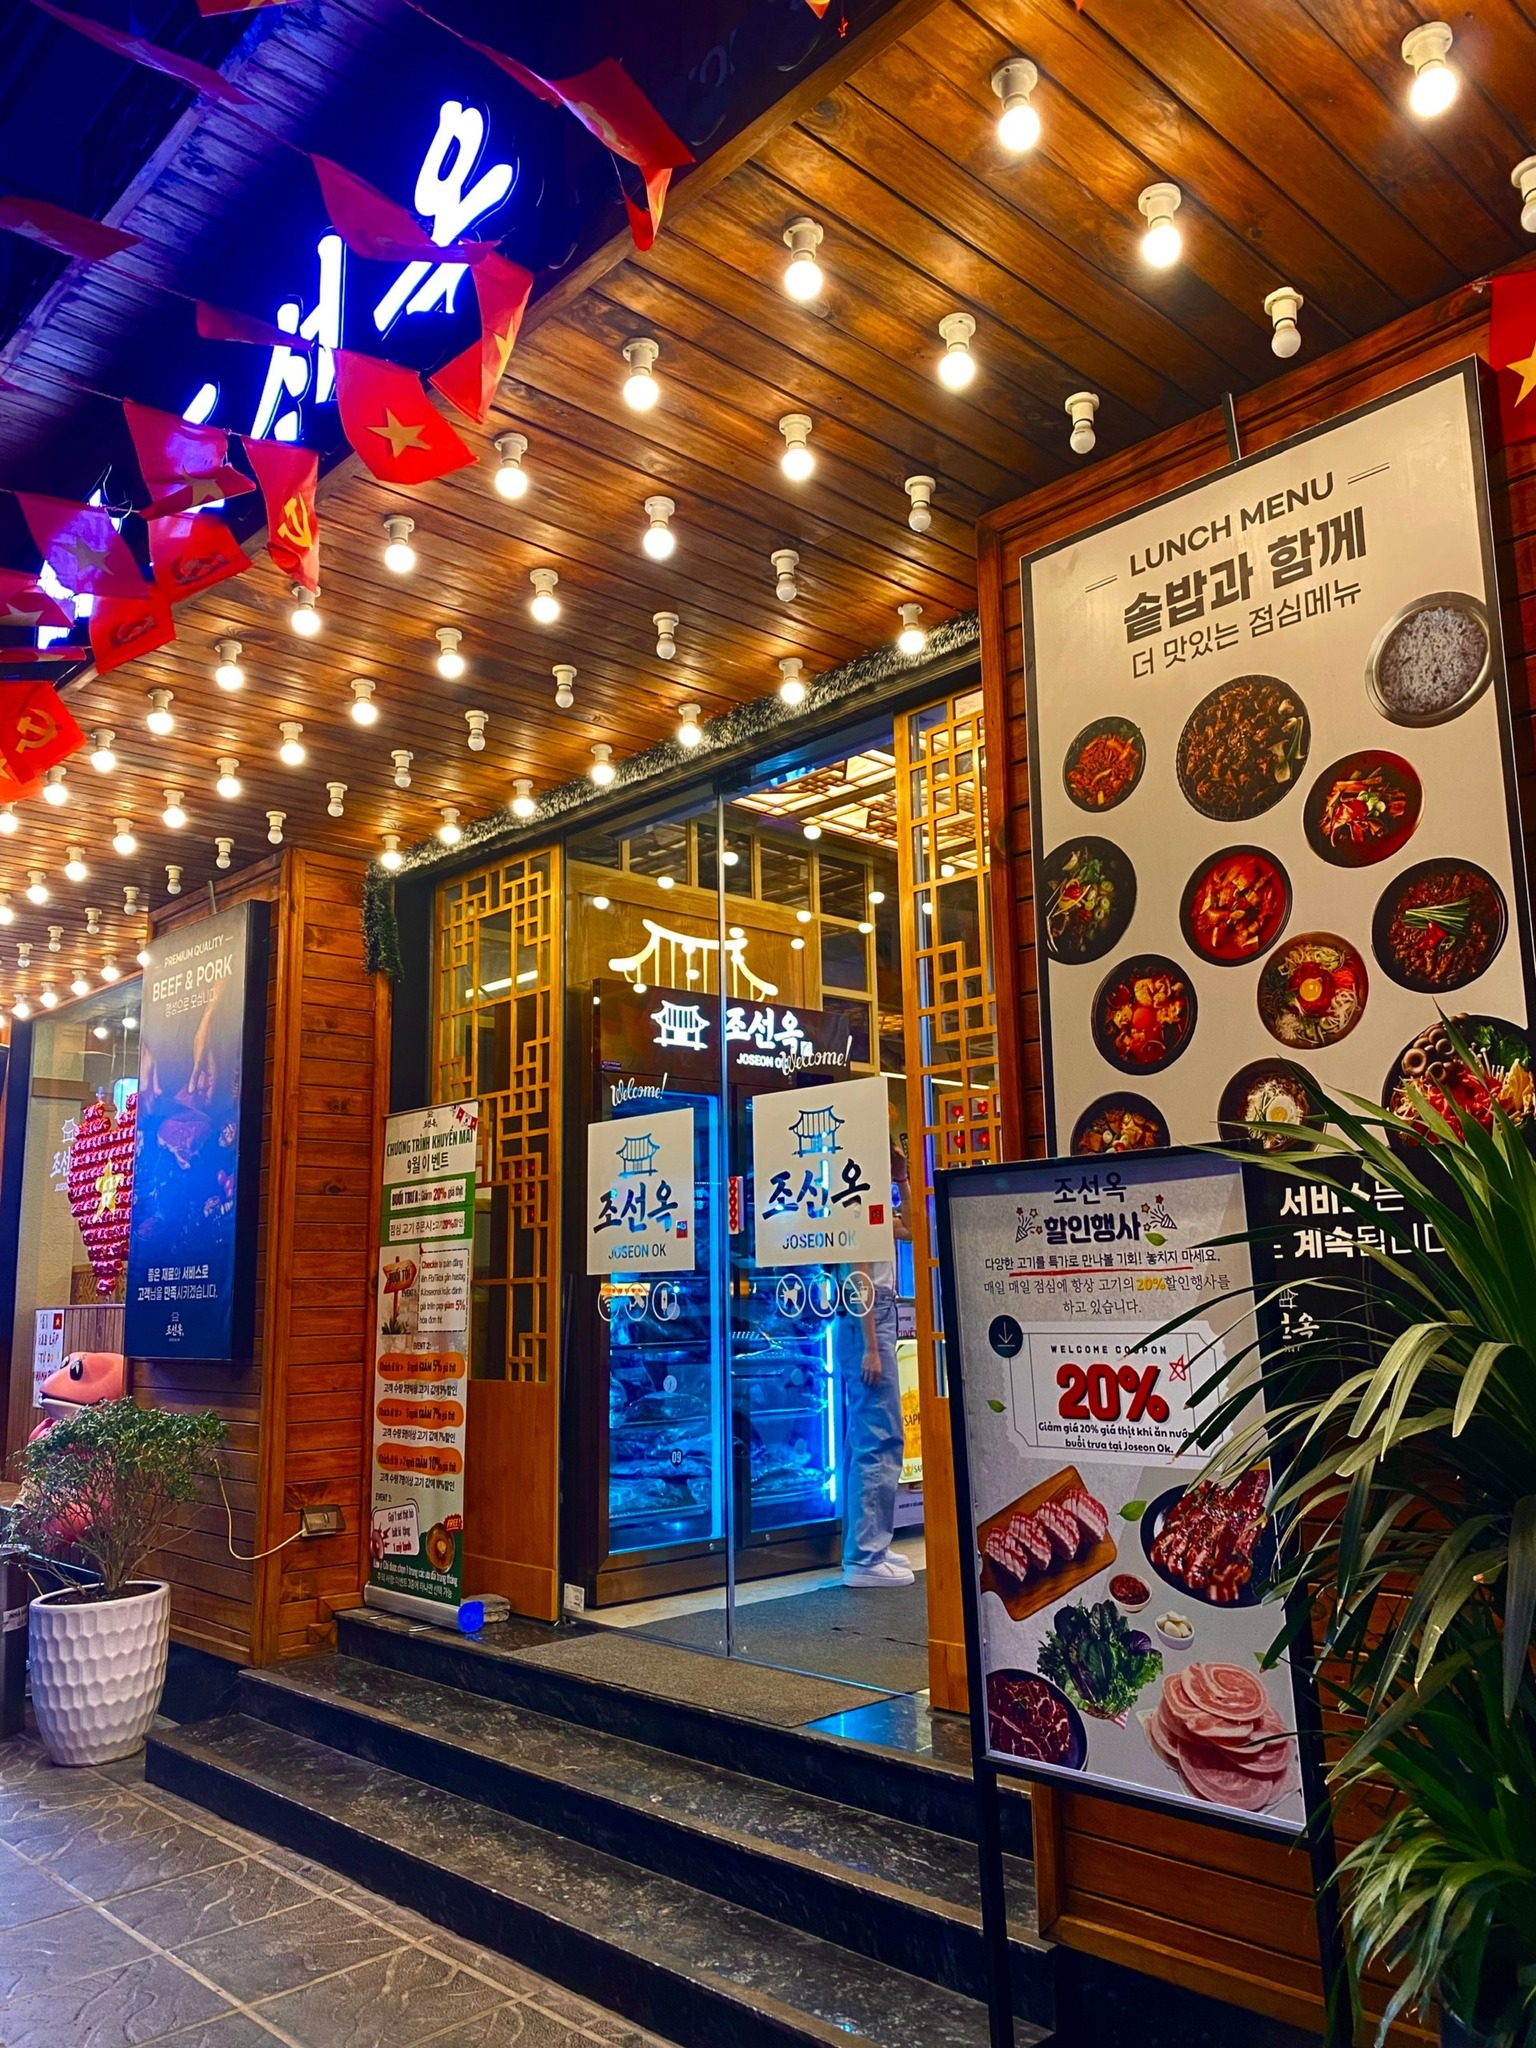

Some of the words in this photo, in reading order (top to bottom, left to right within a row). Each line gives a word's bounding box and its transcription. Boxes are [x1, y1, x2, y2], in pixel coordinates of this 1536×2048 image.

[1130, 514, 1231, 577] LUNCH
[1240, 471, 1333, 531] MENU
[1124, 552, 1254, 643] 솥밥과
[1268, 506, 1367, 589] 함께
[1132, 647, 1154, 679] 더
[1164, 622, 1239, 669] 맛있는
[1249, 580, 1361, 638] 점심메뉴
[164, 948, 194, 968] PREMIUM
[194, 934, 224, 956] QUALITY
[152, 974, 183, 1002] BEEF
[184, 970, 193, 991] &
[196, 954, 233, 987] PORK
[725, 1007, 804, 1054] 조선옥
[736, 1052, 774, 1068] JOSEON
[781, 1035, 853, 1076] Welcome!
[610, 1072, 668, 1107] Welcome!
[422, 1152, 449, 1172] 이벤트
[433, 1187, 447, 1201] 20%
[762, 1158, 871, 1219] 조선옥
[1053, 1171, 1127, 1205] 조선옥
[593, 1179, 678, 1234] 조선옥
[1044, 1212, 1141, 1245] 할인행사
[782, 1231, 834, 1250] JOSEON
[608, 1244, 649, 1260] JOSEON
[651, 1243, 666, 1258] OK
[985, 1256, 1014, 1271] 다양한
[1017, 1255, 1045, 1270] 고기를
[1048, 1254, 1079, 1269] 특가로
[1081, 1252, 1114, 1268] 만나볼
[1116, 1251, 1143, 1266] 기회!
[1146, 1250, 1178, 1265] 놓치지
[148, 1267, 160, 1282] 좋은
[161, 1266, 182, 1281] 재료와
[182, 1264, 209, 1280] 서비스로
[137, 1286, 162, 1301] 고객님을
[984, 1279, 1005, 1295] 매일
[1008, 1279, 1030, 1294] 매일
[1034, 1278, 1068, 1294] 점심에
[1072, 1277, 1094, 1293] 항상
[1098, 1276, 1134, 1293] 고기의
[1063, 1299, 1087, 1314] 하고
[1090, 1298, 1142, 1316] 있습니다.
[1050, 1345, 1109, 1354] WELCOME
[1056, 1363, 1170, 1423] 20%
[1038, 1421, 1062, 1433] Giảm
[1063, 1423, 1079, 1434] giá
[1080, 1424, 1099, 1435] 20%
[1101, 1424, 1116, 1437] giá
[1117, 1426, 1135, 1439] thịt
[1136, 1426, 1153, 1437] khi
[1154, 1426, 1168, 1438] ăn
[1065, 1435, 1085, 1449] buổi
[1087, 1438, 1107, 1450] trưa
[1108, 1440, 1123, 1453] tại
[1124, 1441, 1156, 1453] Joseon
[1157, 1443, 1174, 1453] Ok.
[672, 1450, 681, 1463] 09
